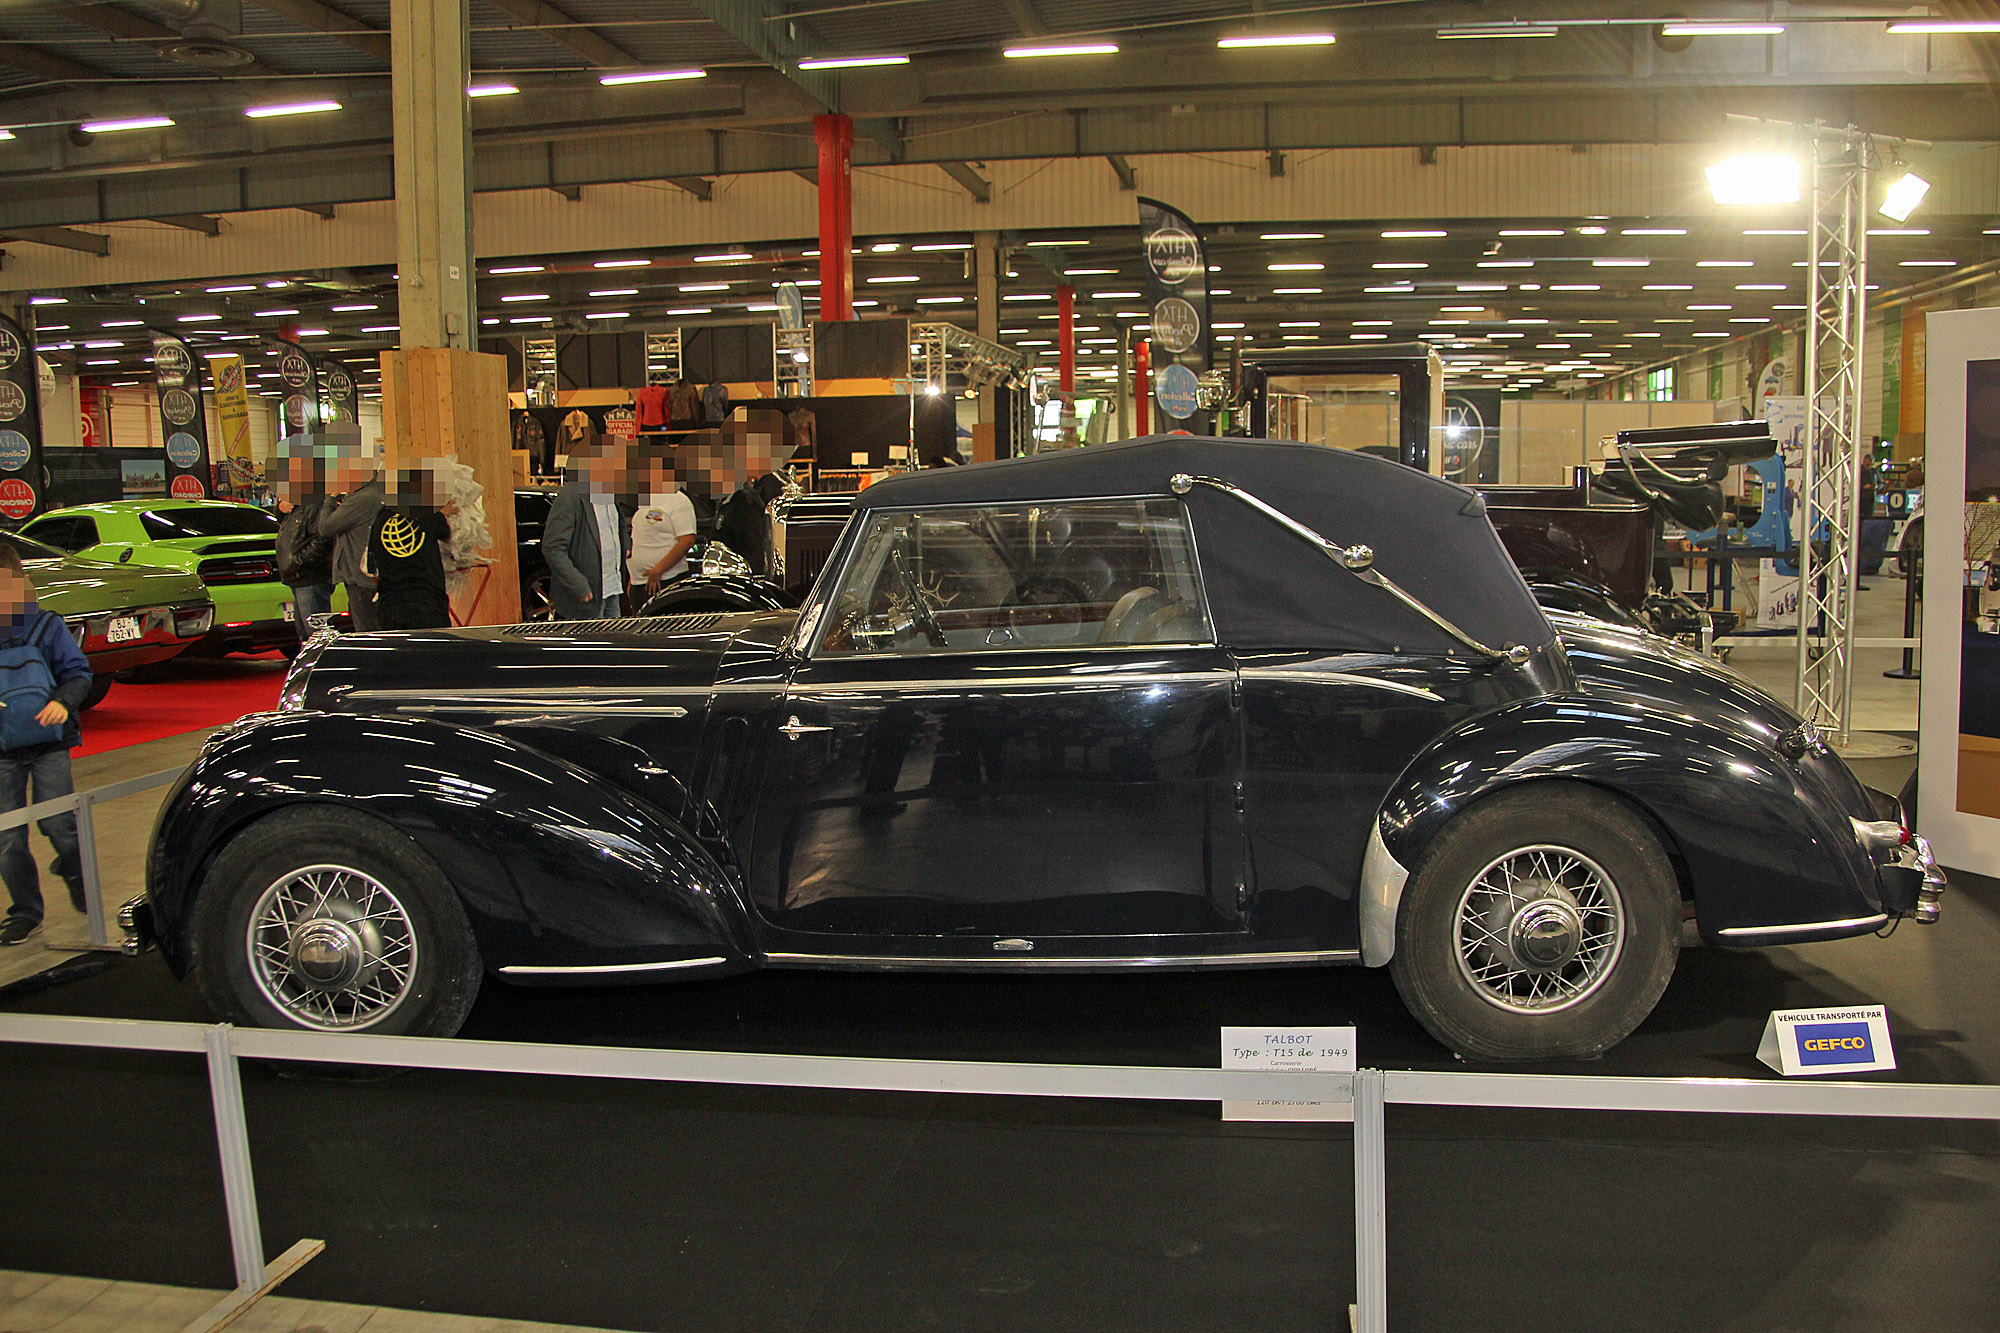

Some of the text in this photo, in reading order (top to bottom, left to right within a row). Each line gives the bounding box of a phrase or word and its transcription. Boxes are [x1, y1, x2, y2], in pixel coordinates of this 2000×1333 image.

[1445, 407, 1469, 427] TX
[1777, 1011, 1882, 1022] VÉHICULE TRANSPORTÉ PAR
[1264, 1034, 1313, 1045] TALBOT
[1804, 1036, 1866, 1051] GEFCO
[1233, 1048, 1260, 1060] Type
[1273, 1048, 1294, 1058] T15
[1298, 1047, 1314, 1058] de
[1320, 1048, 1349, 1058] 1949
